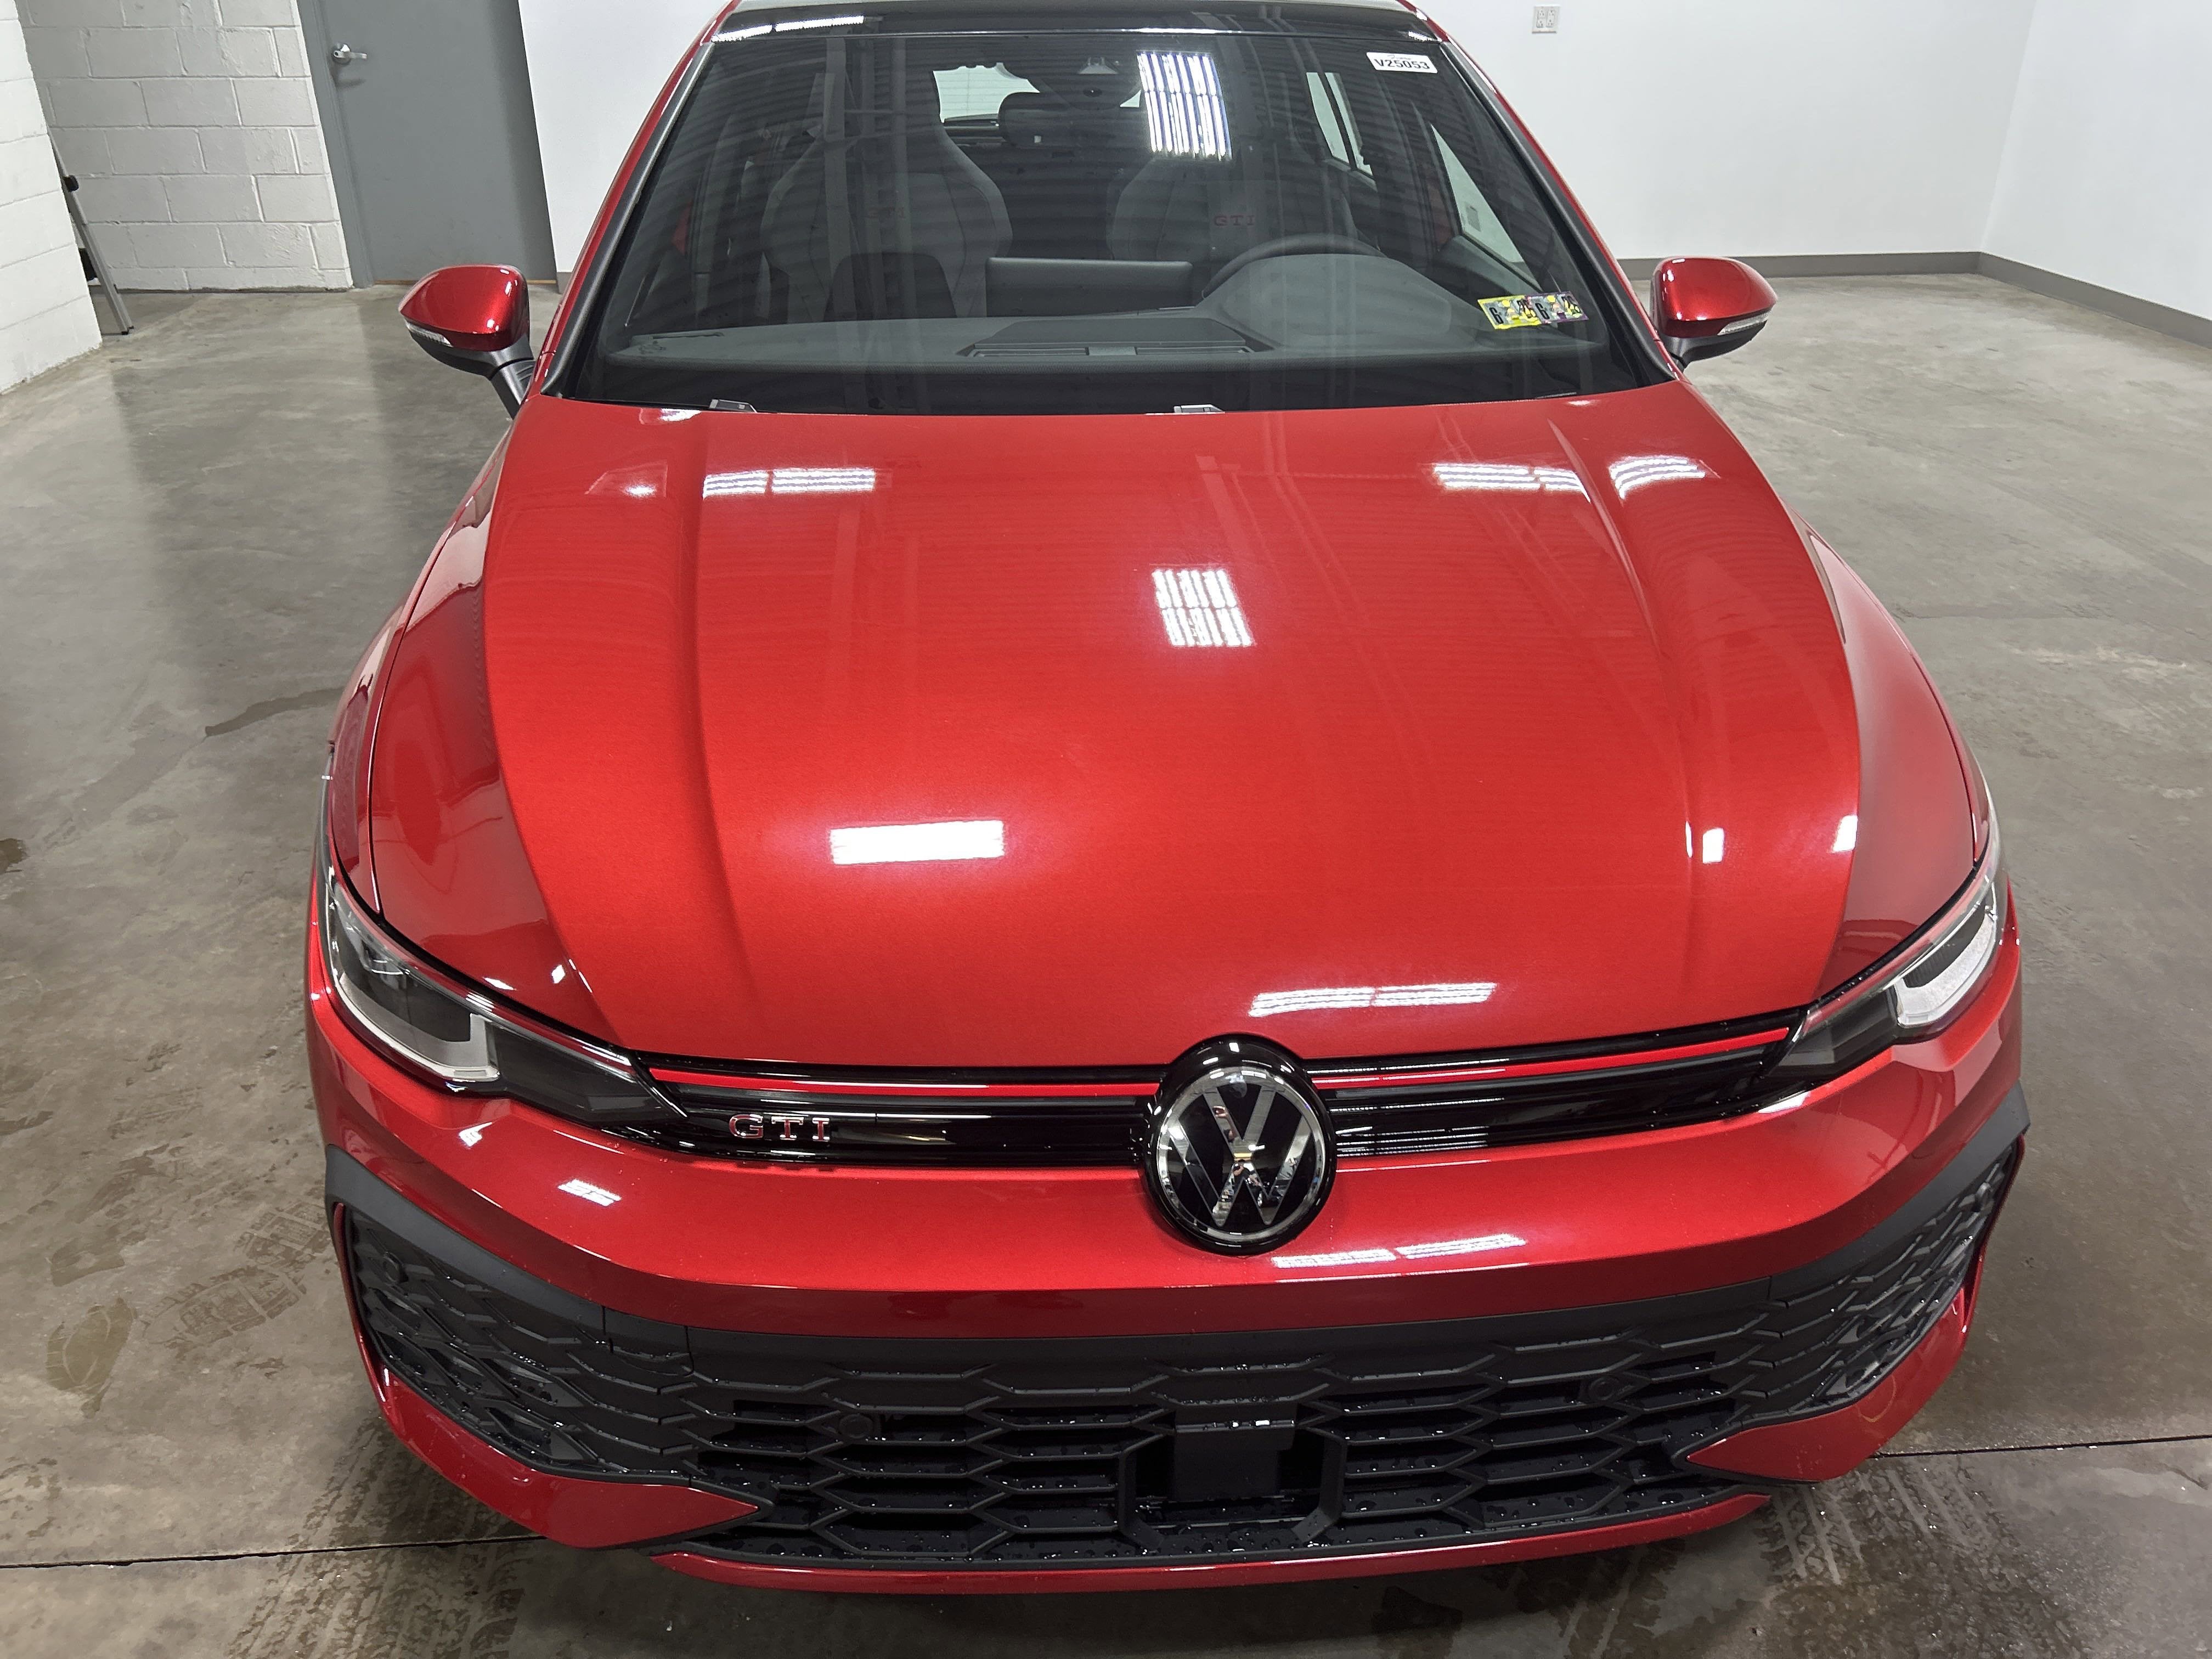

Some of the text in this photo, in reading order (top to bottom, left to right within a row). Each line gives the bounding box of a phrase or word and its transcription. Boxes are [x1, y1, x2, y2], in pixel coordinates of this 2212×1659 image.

[1373, 58, 1431, 70] V25053
[1214, 215, 1255, 227] GTI
[1489, 307, 1504, 324] 6
[1534, 302, 1550, 320] 6
[729, 1114, 830, 1142] GTI
[1167, 1084, 1313, 1228] VW
